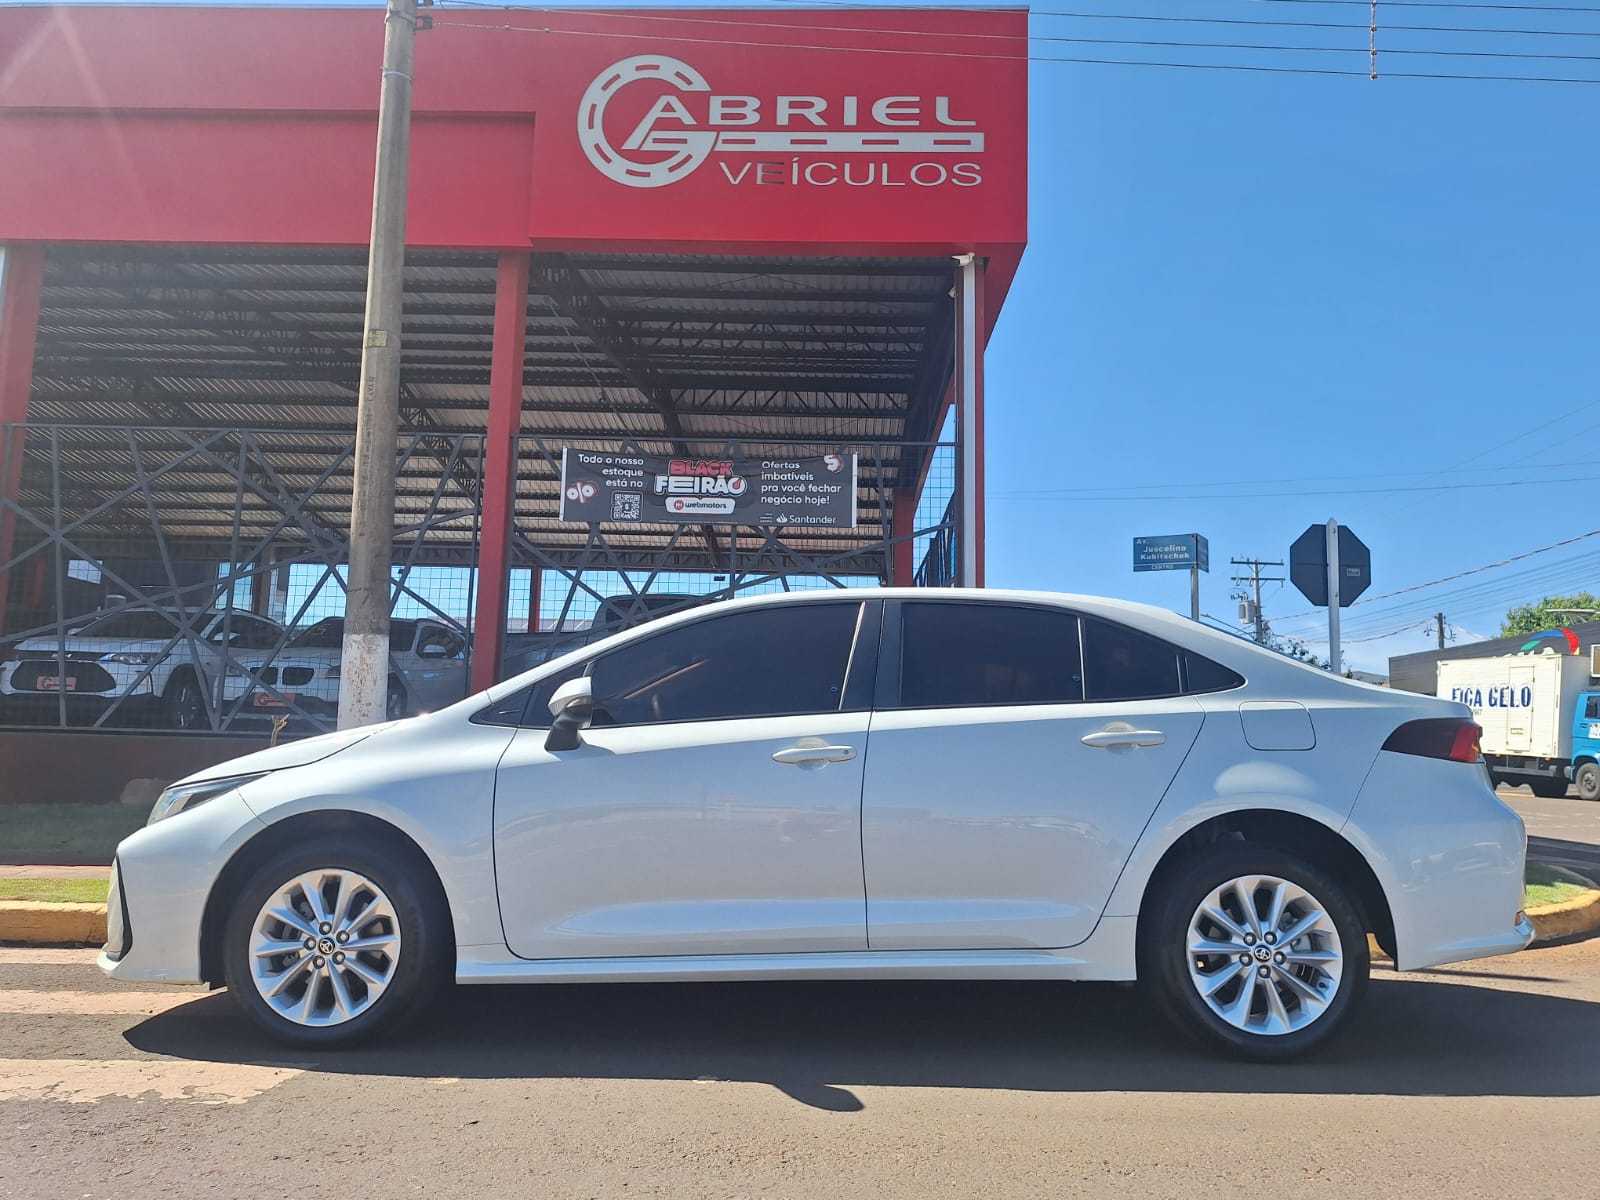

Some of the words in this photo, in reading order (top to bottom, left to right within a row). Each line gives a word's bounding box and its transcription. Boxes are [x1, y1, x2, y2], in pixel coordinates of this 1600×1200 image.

[577, 54, 978, 188] GABRIEL
[719, 156, 983, 186] VEÍCULOS
[579, 453, 603, 464] Todo
[615, 457, 644, 466] nosso
[761, 461, 801, 469] Ofertas
[602, 468, 644, 478] estoque
[669, 460, 733, 475] BLACK
[761, 471, 814, 481] imbatíveis
[605, 479, 628, 488] está
[655, 475, 746, 495] FEIRÃO
[761, 485, 779, 494] pra
[781, 483, 806, 492] você
[808, 483, 842, 493] fechar
[685, 501, 727, 509] webmotors
[761, 496, 802, 506] negócio
[804, 495, 830, 507] hoje!
[789, 515, 837, 524] Santander
[1488, 686, 1531, 707] GELO
